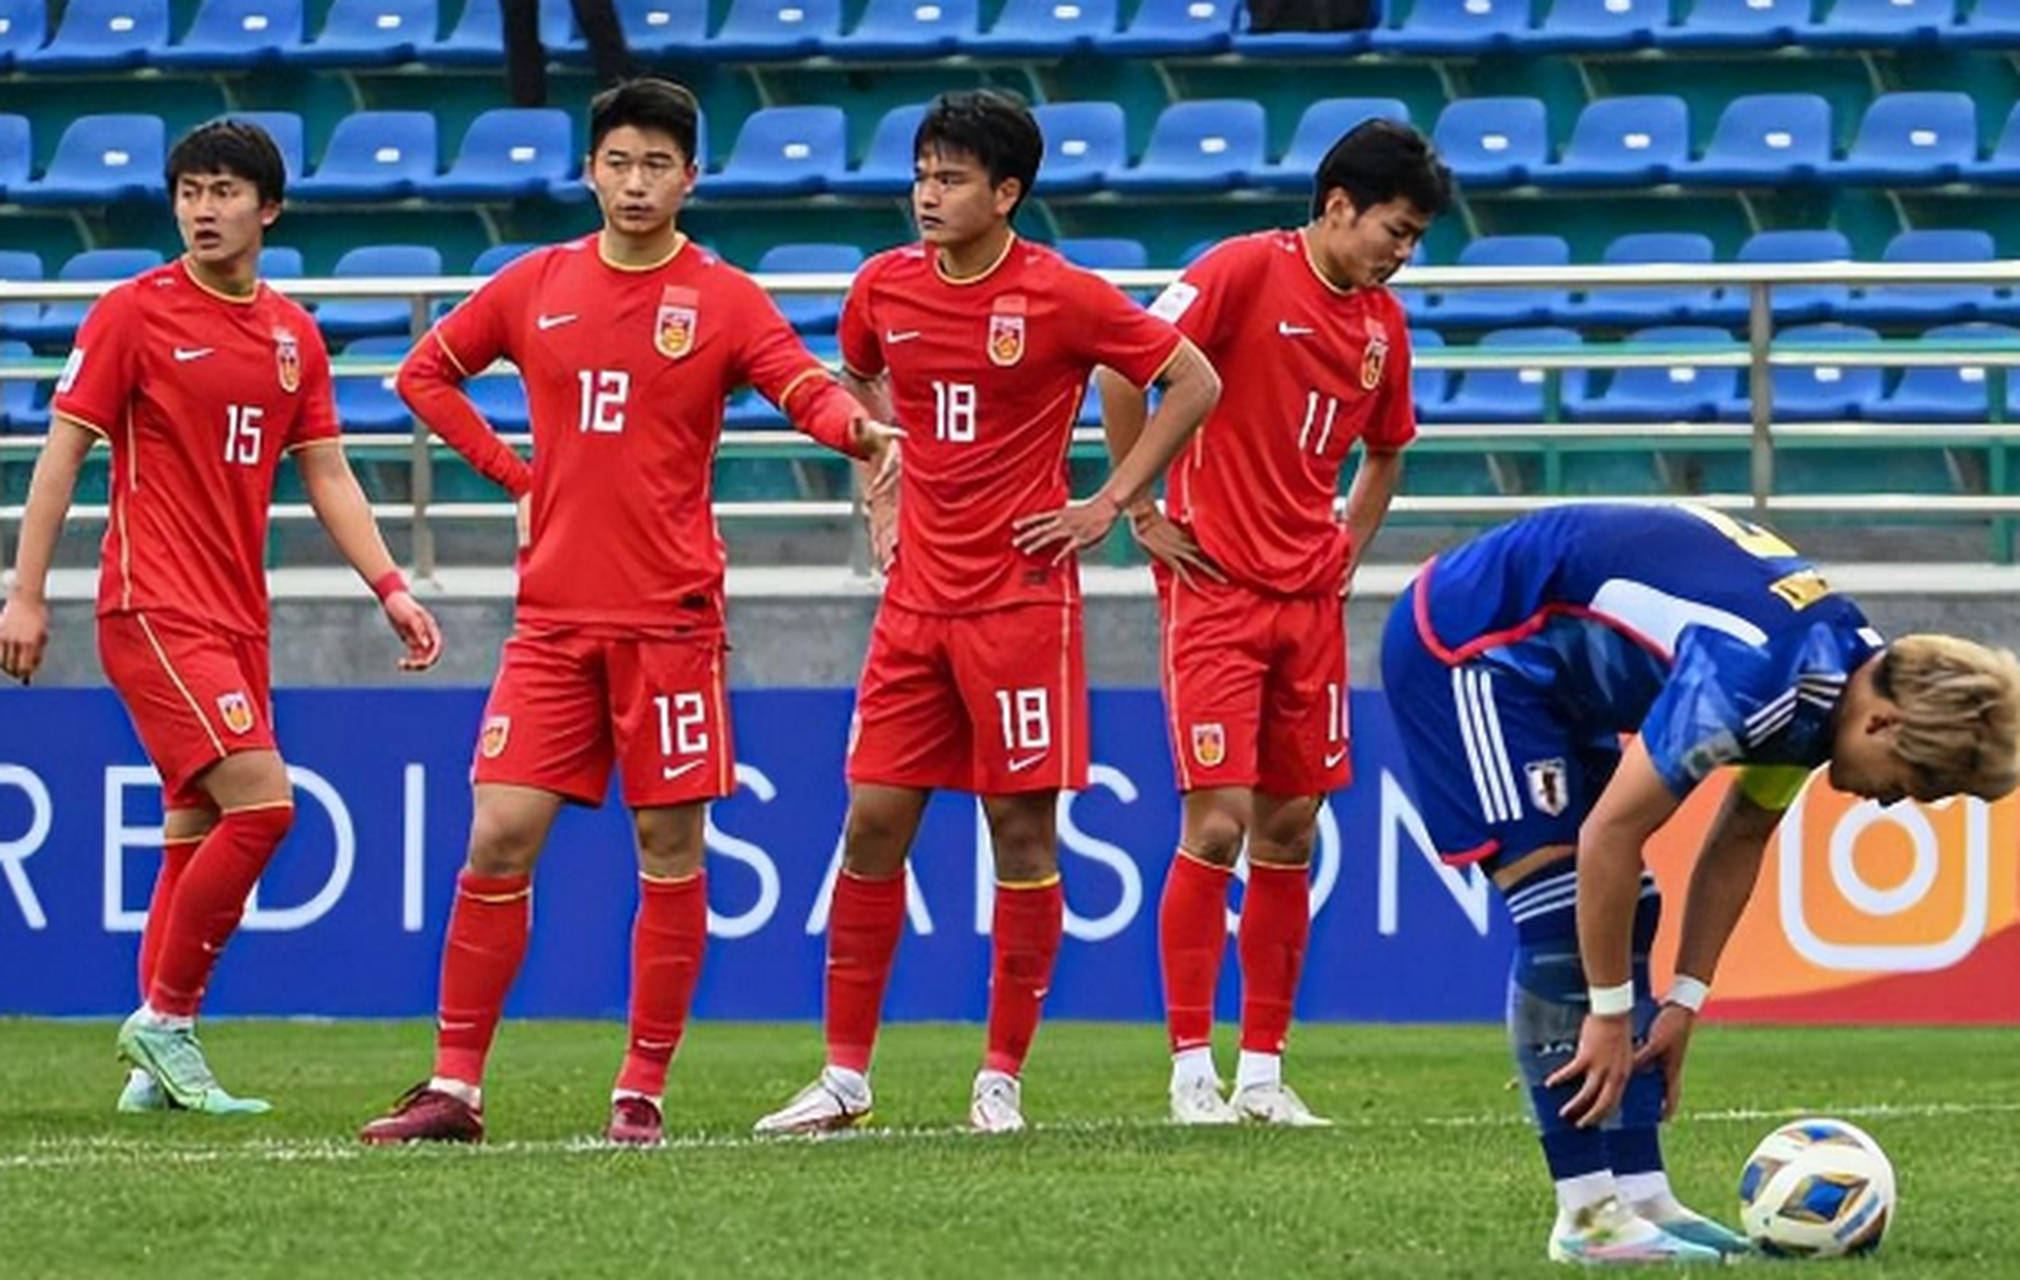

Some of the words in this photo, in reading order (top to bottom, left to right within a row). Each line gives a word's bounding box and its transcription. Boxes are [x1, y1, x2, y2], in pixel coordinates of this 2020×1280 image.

[578, 369, 630, 433] 12
[932, 379, 976, 442] 18
[1298, 391, 1338, 455] 11
[225, 404, 264, 465] 15
[653, 691, 709, 757] 12
[995, 687, 1051, 750] 18
